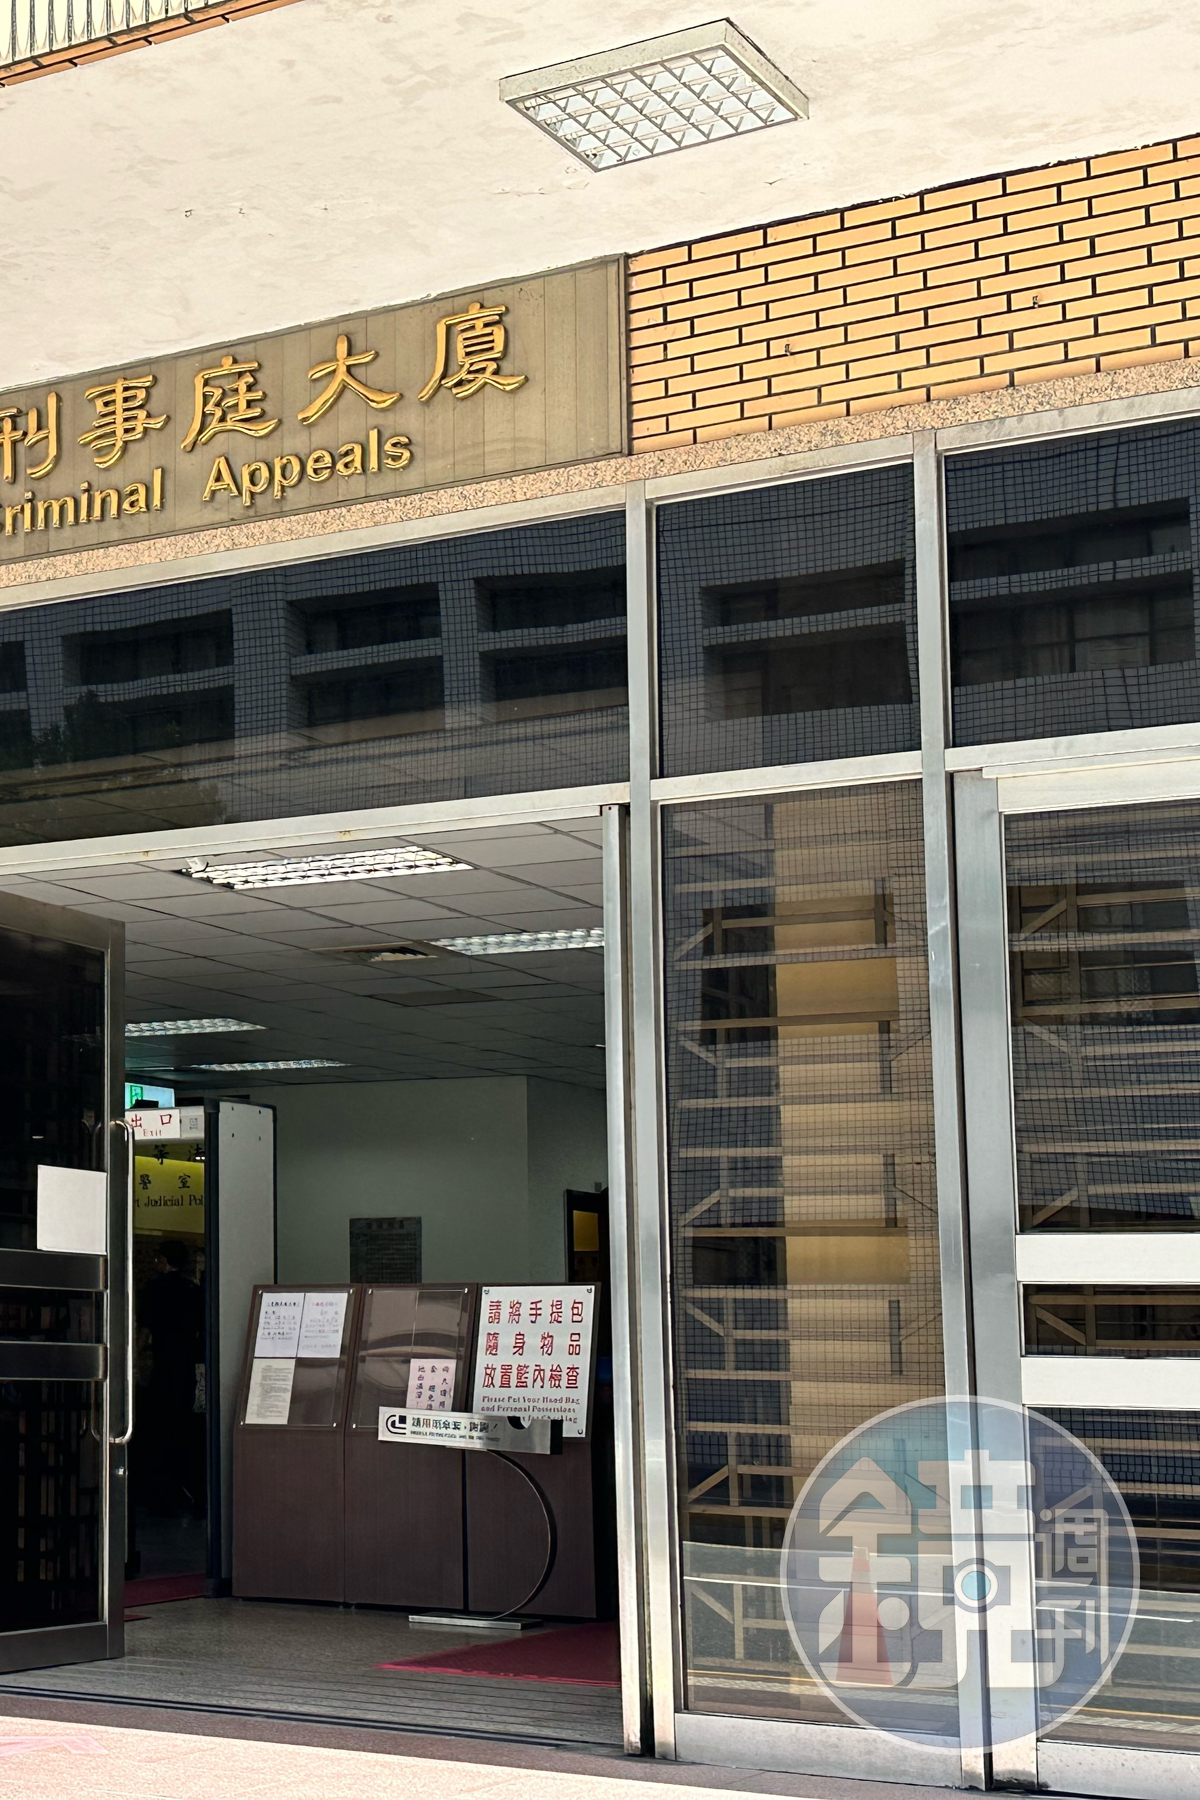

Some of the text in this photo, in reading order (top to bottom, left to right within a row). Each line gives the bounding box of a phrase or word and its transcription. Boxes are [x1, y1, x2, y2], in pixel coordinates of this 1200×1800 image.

[202, 428, 413, 506] Appeals
[131, 1114, 172, 1128] 出口
[144, 1195, 184, 1207] Judicial
[487, 1299, 584, 1325] 請將手提包
[485, 1332, 582, 1356] 隨身物品
